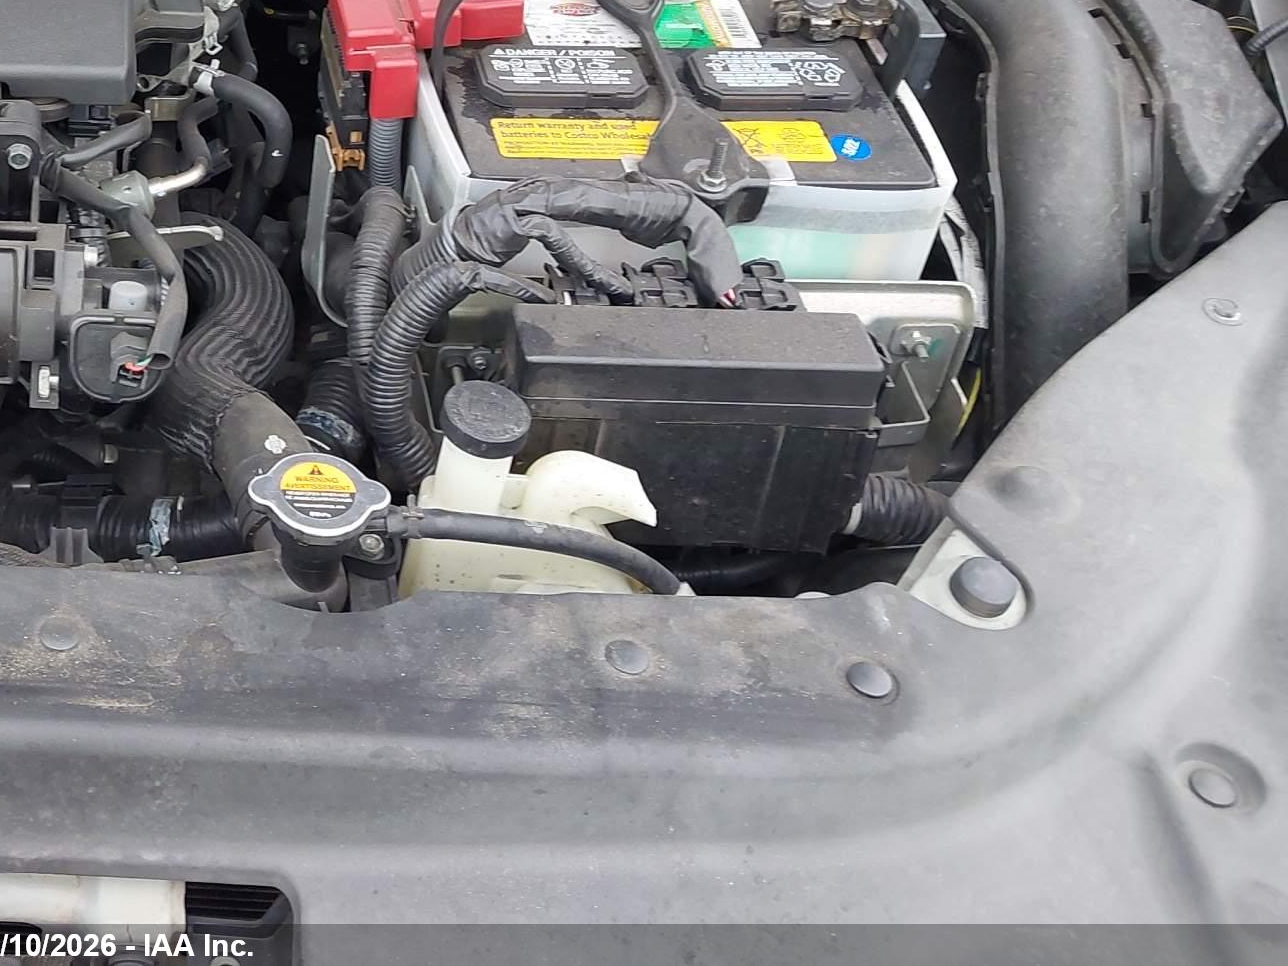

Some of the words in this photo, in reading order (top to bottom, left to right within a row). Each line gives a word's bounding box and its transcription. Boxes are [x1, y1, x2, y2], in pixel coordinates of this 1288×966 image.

[497, 121, 535, 129] Return
[537, 122, 585, 131] warranty
[588, 122, 609, 130] and
[611, 121, 637, 130] used
[501, 131, 549, 139] batteries
[285, 483, 351, 491] AVERTISSEMENT
